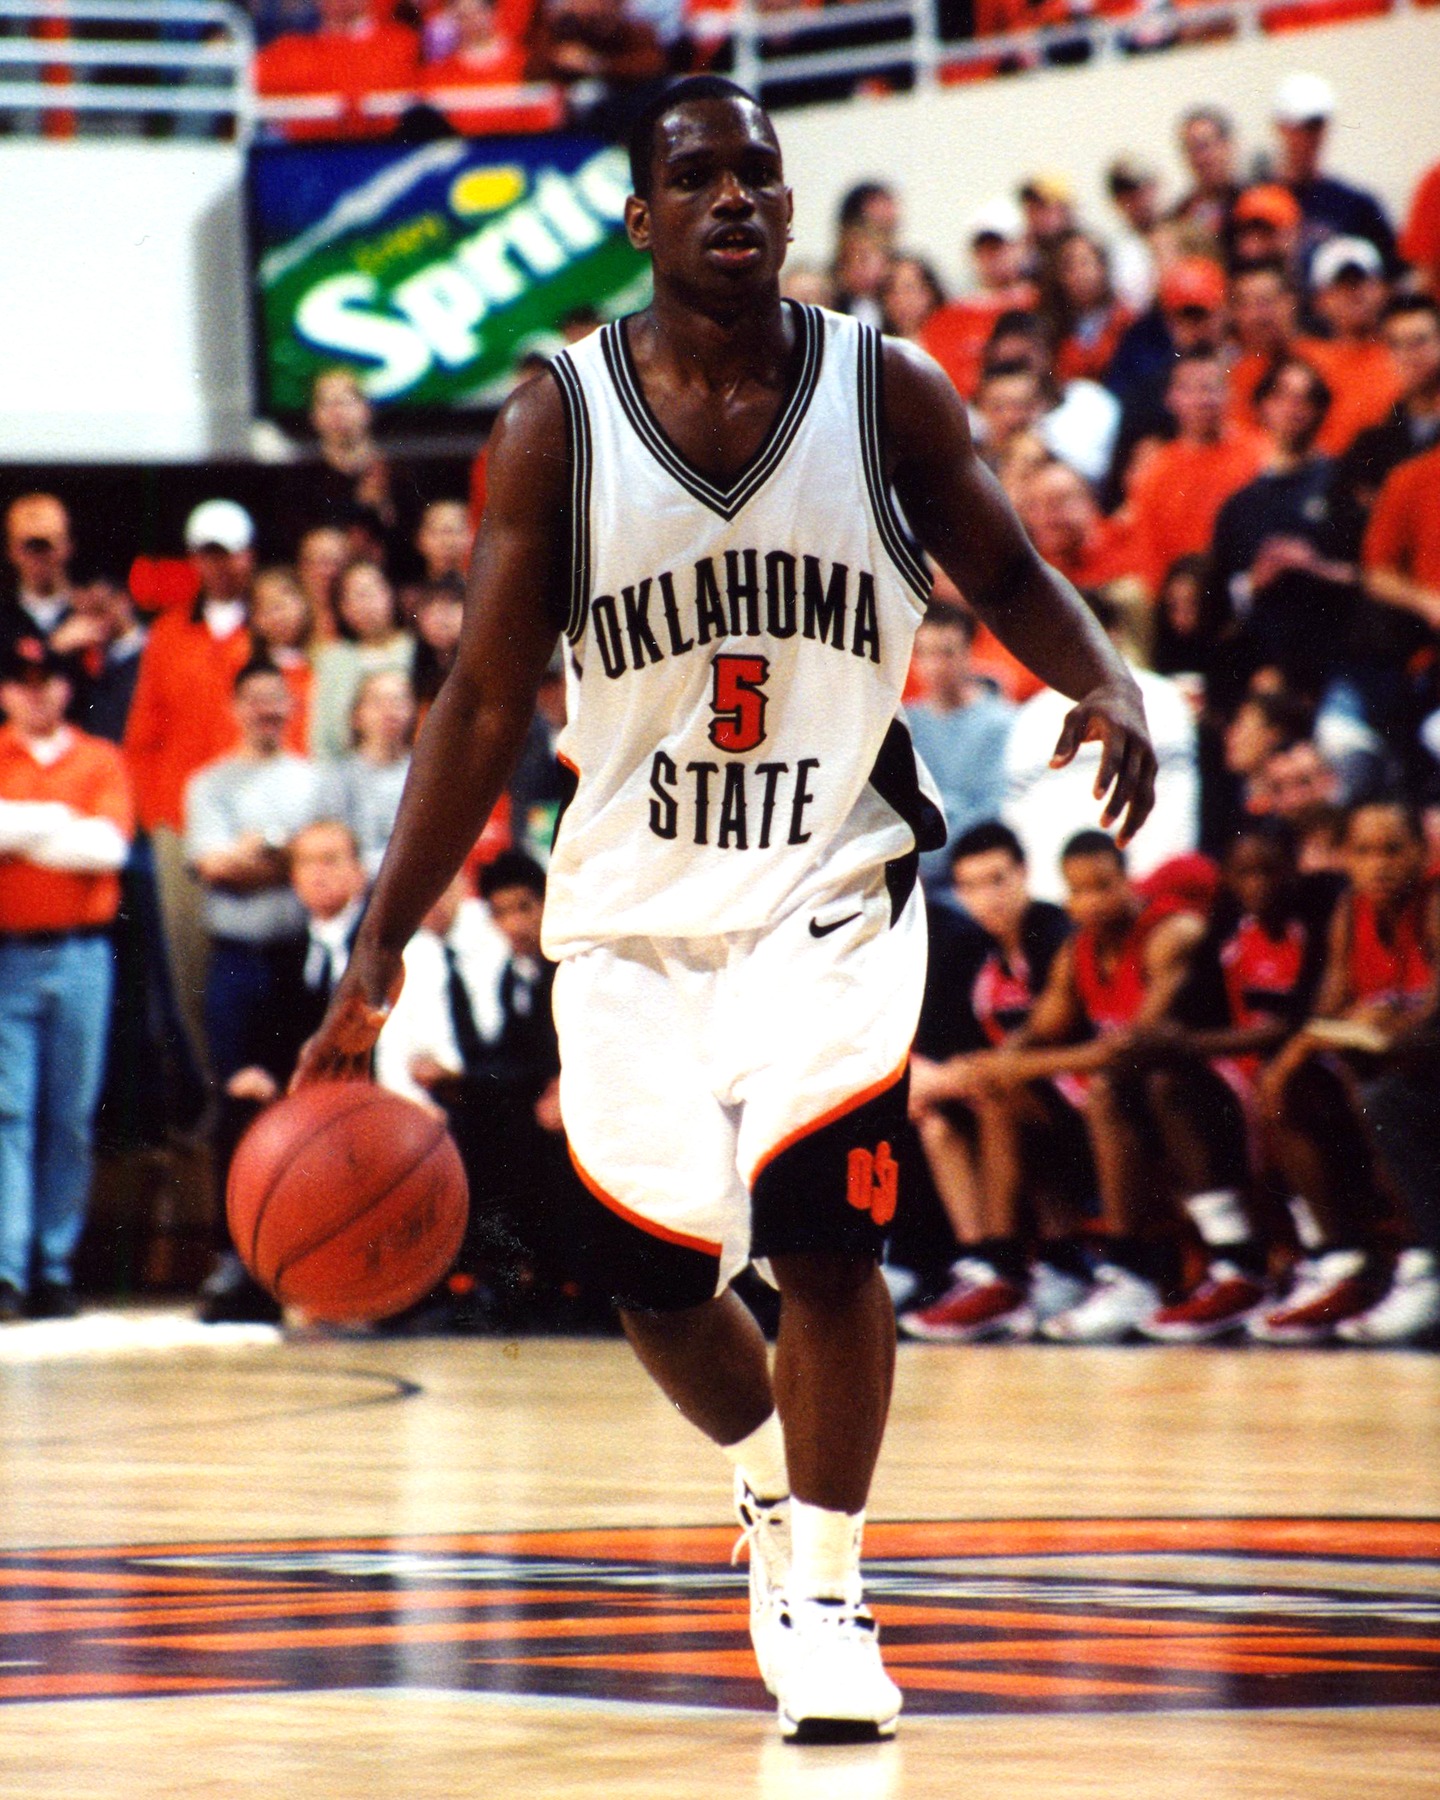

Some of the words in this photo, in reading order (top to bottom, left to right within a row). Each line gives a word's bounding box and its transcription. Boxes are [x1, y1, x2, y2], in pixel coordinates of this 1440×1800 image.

[591, 548, 881, 680] OKLAHOMA
[708, 653, 770, 754] 5
[649, 750, 820, 850] STATE
